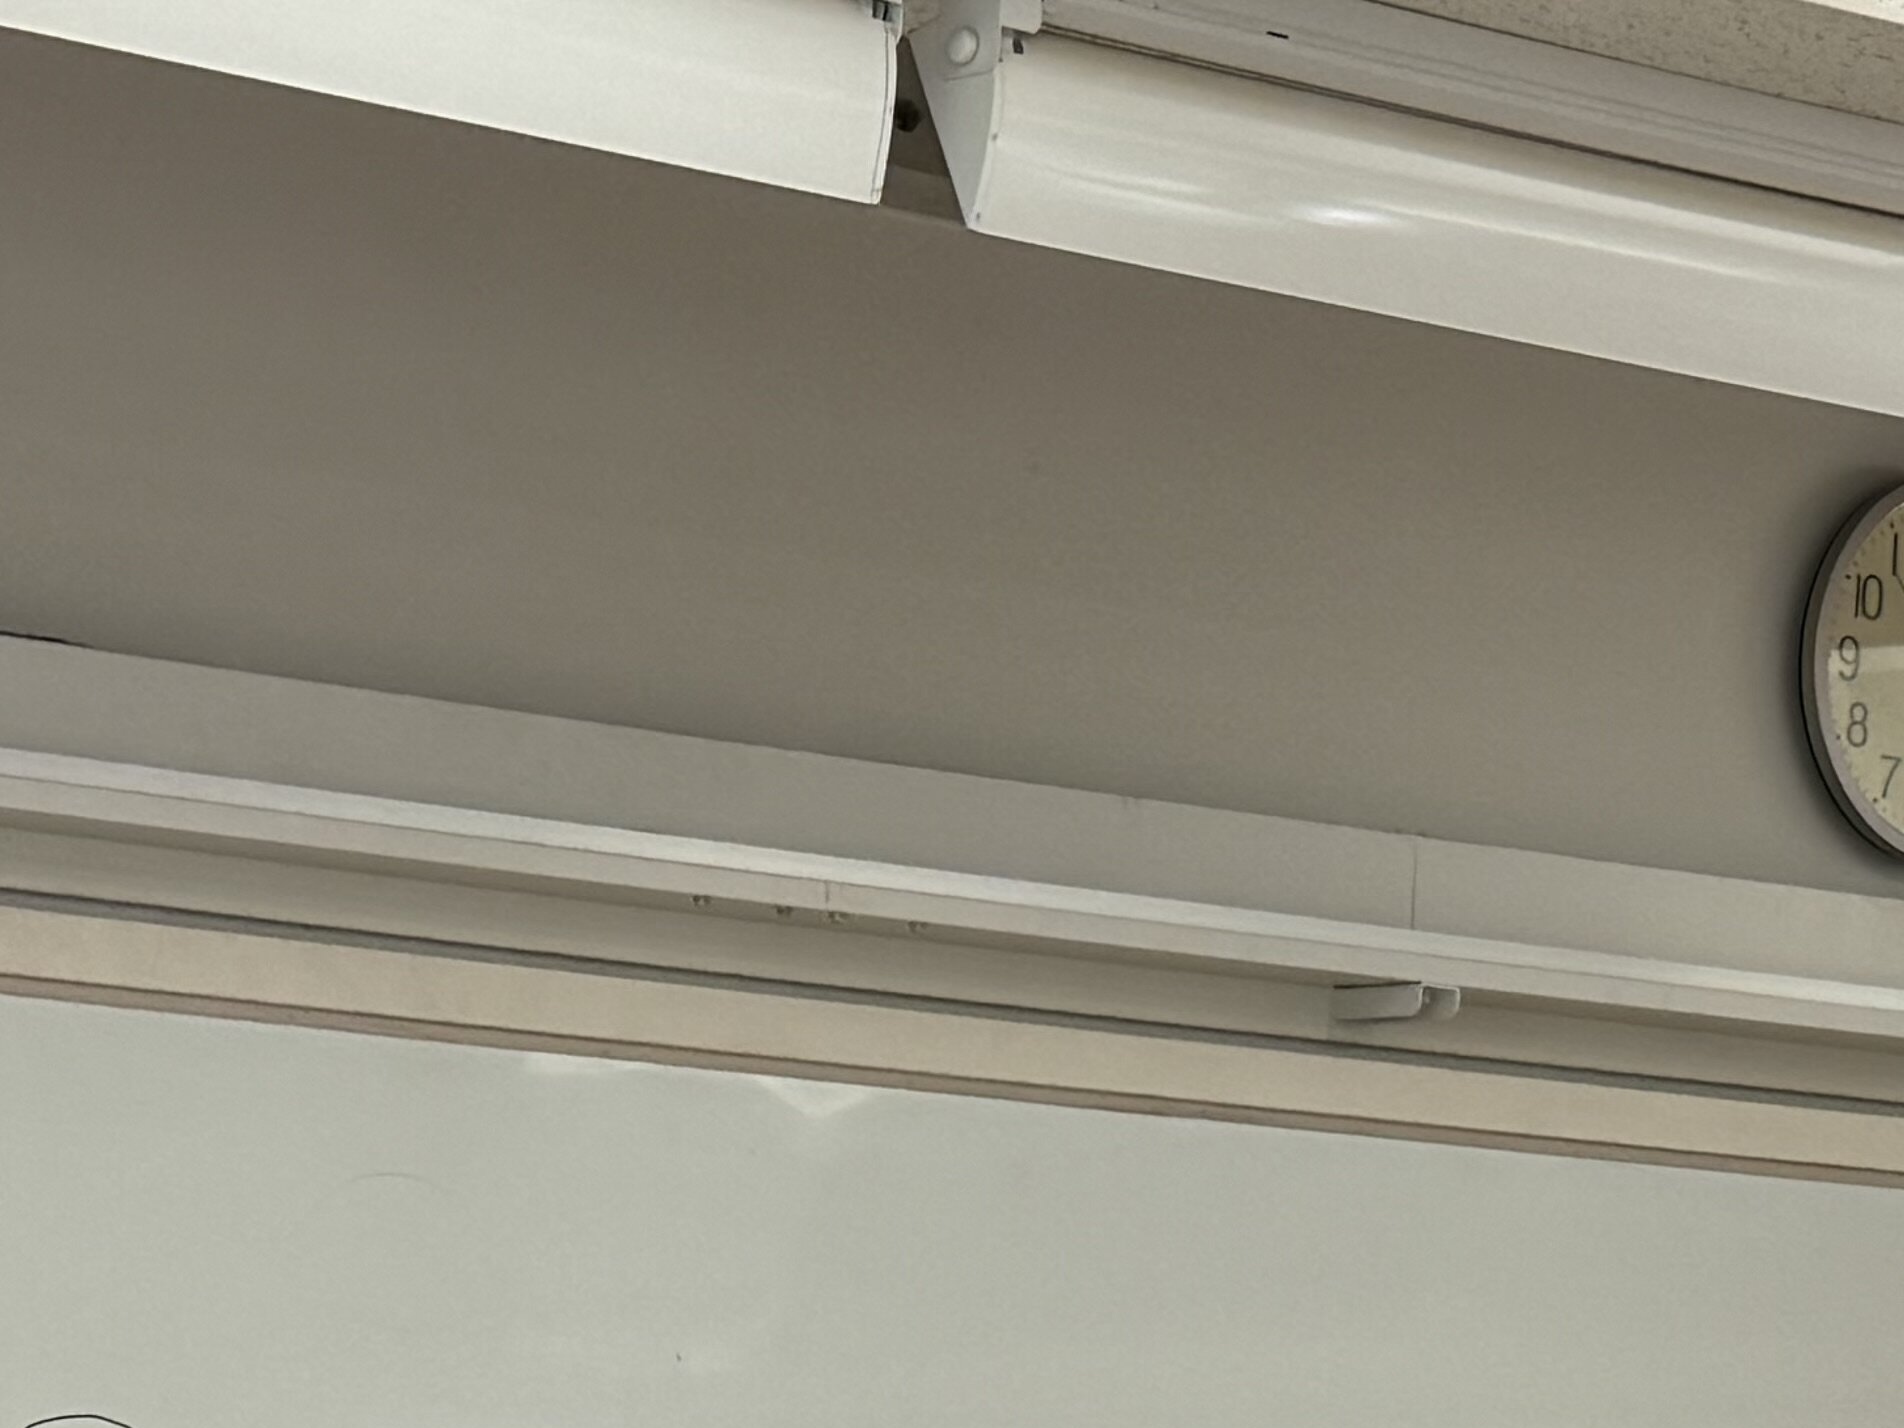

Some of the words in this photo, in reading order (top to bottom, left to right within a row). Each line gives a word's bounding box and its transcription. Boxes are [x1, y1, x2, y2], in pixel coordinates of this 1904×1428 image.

[1854, 573, 1884, 621] 10
[1837, 634, 1860, 681] 9
[1846, 701, 1868, 748] 8
[1880, 754, 1902, 799] 7
